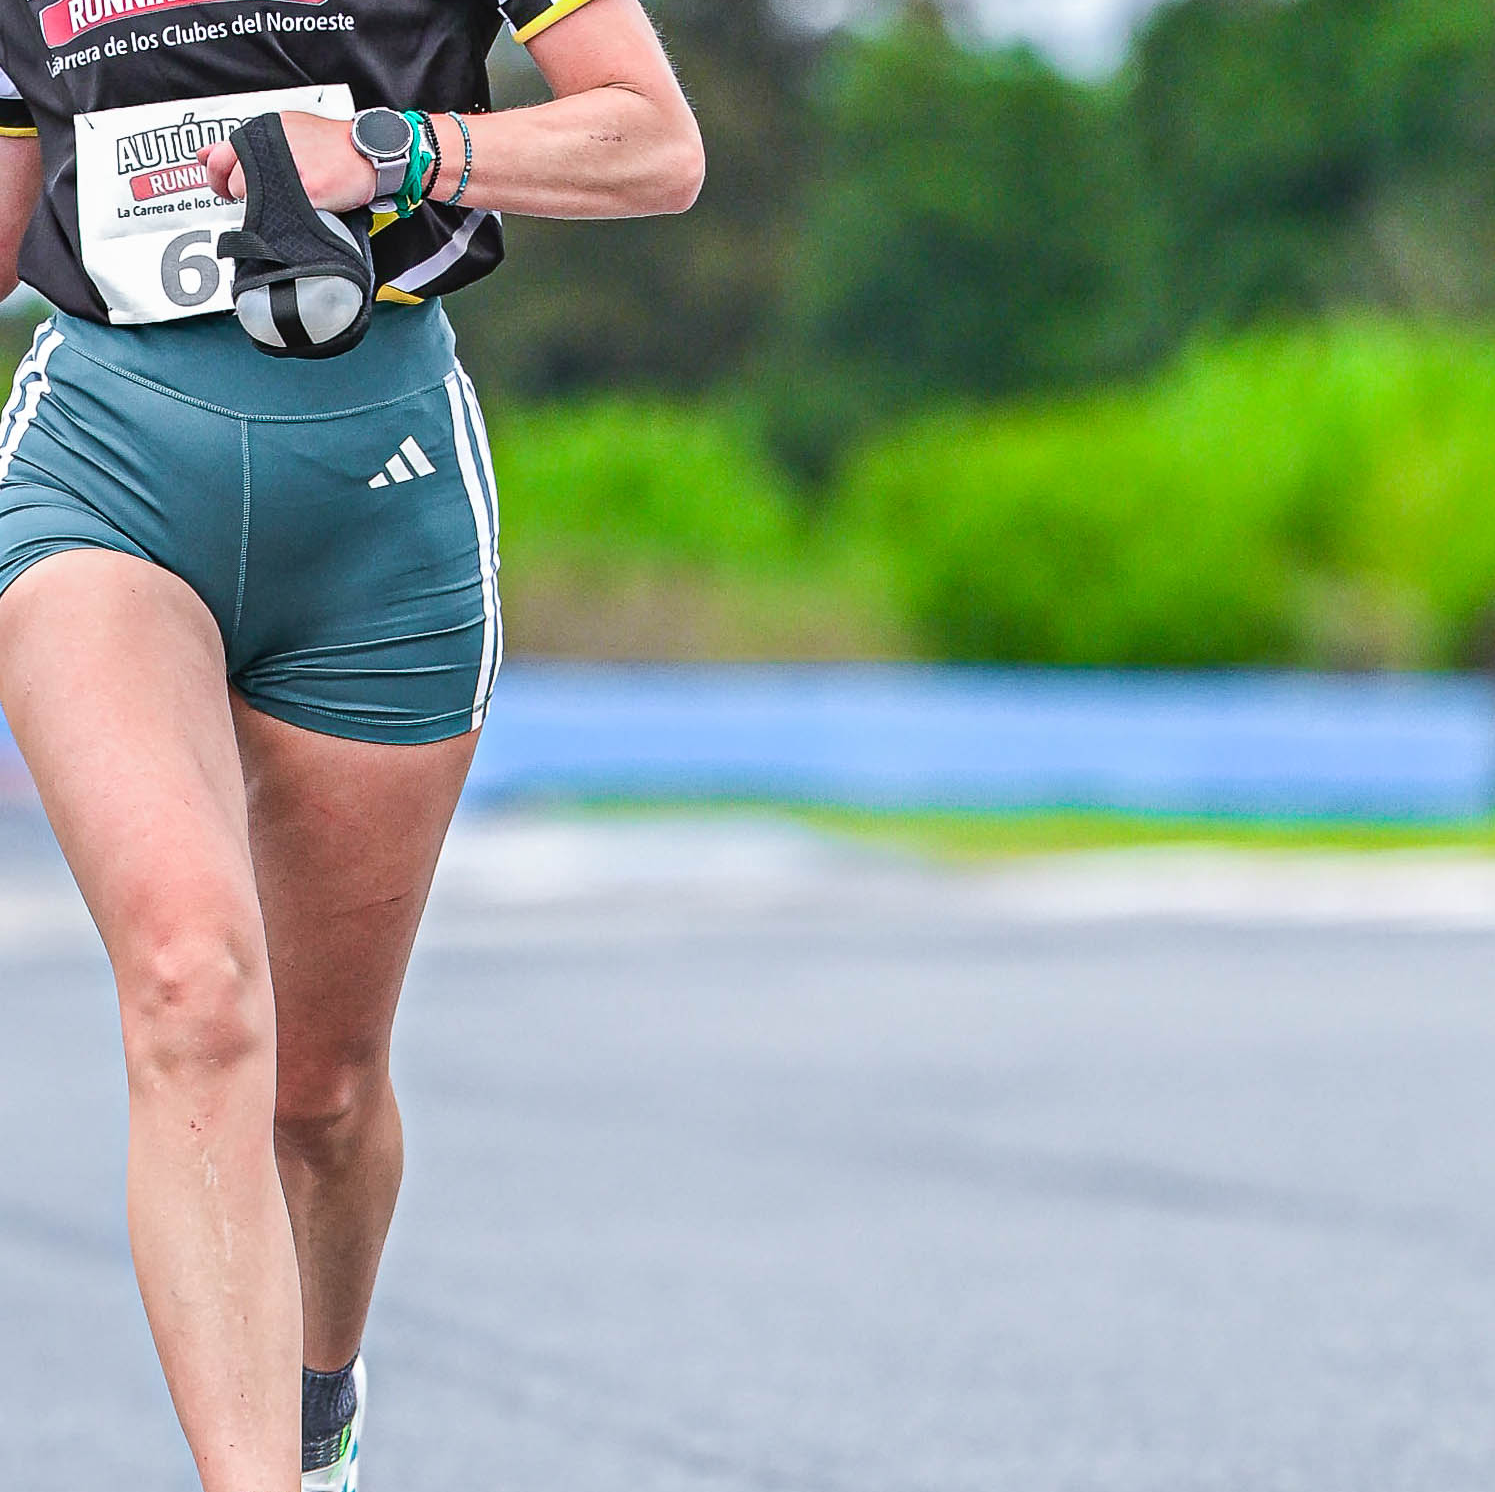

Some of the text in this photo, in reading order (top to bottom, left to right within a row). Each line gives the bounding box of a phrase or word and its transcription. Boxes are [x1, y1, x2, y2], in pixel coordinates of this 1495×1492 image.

[51, 45, 101, 71] arrera
[104, 35, 128, 58] de
[130, 31, 159, 53] los
[162, 20, 228, 47] Clubes
[231, 11, 262, 35] del
[266, 11, 355, 33] Noroeste
[149, 164, 209, 195] RUNNI
[117, 207, 130, 218] La
[133, 201, 175, 216] Carrera
[178, 199, 192, 211] de
[194, 197, 211, 209] los
[161, 227, 241, 307] 6
